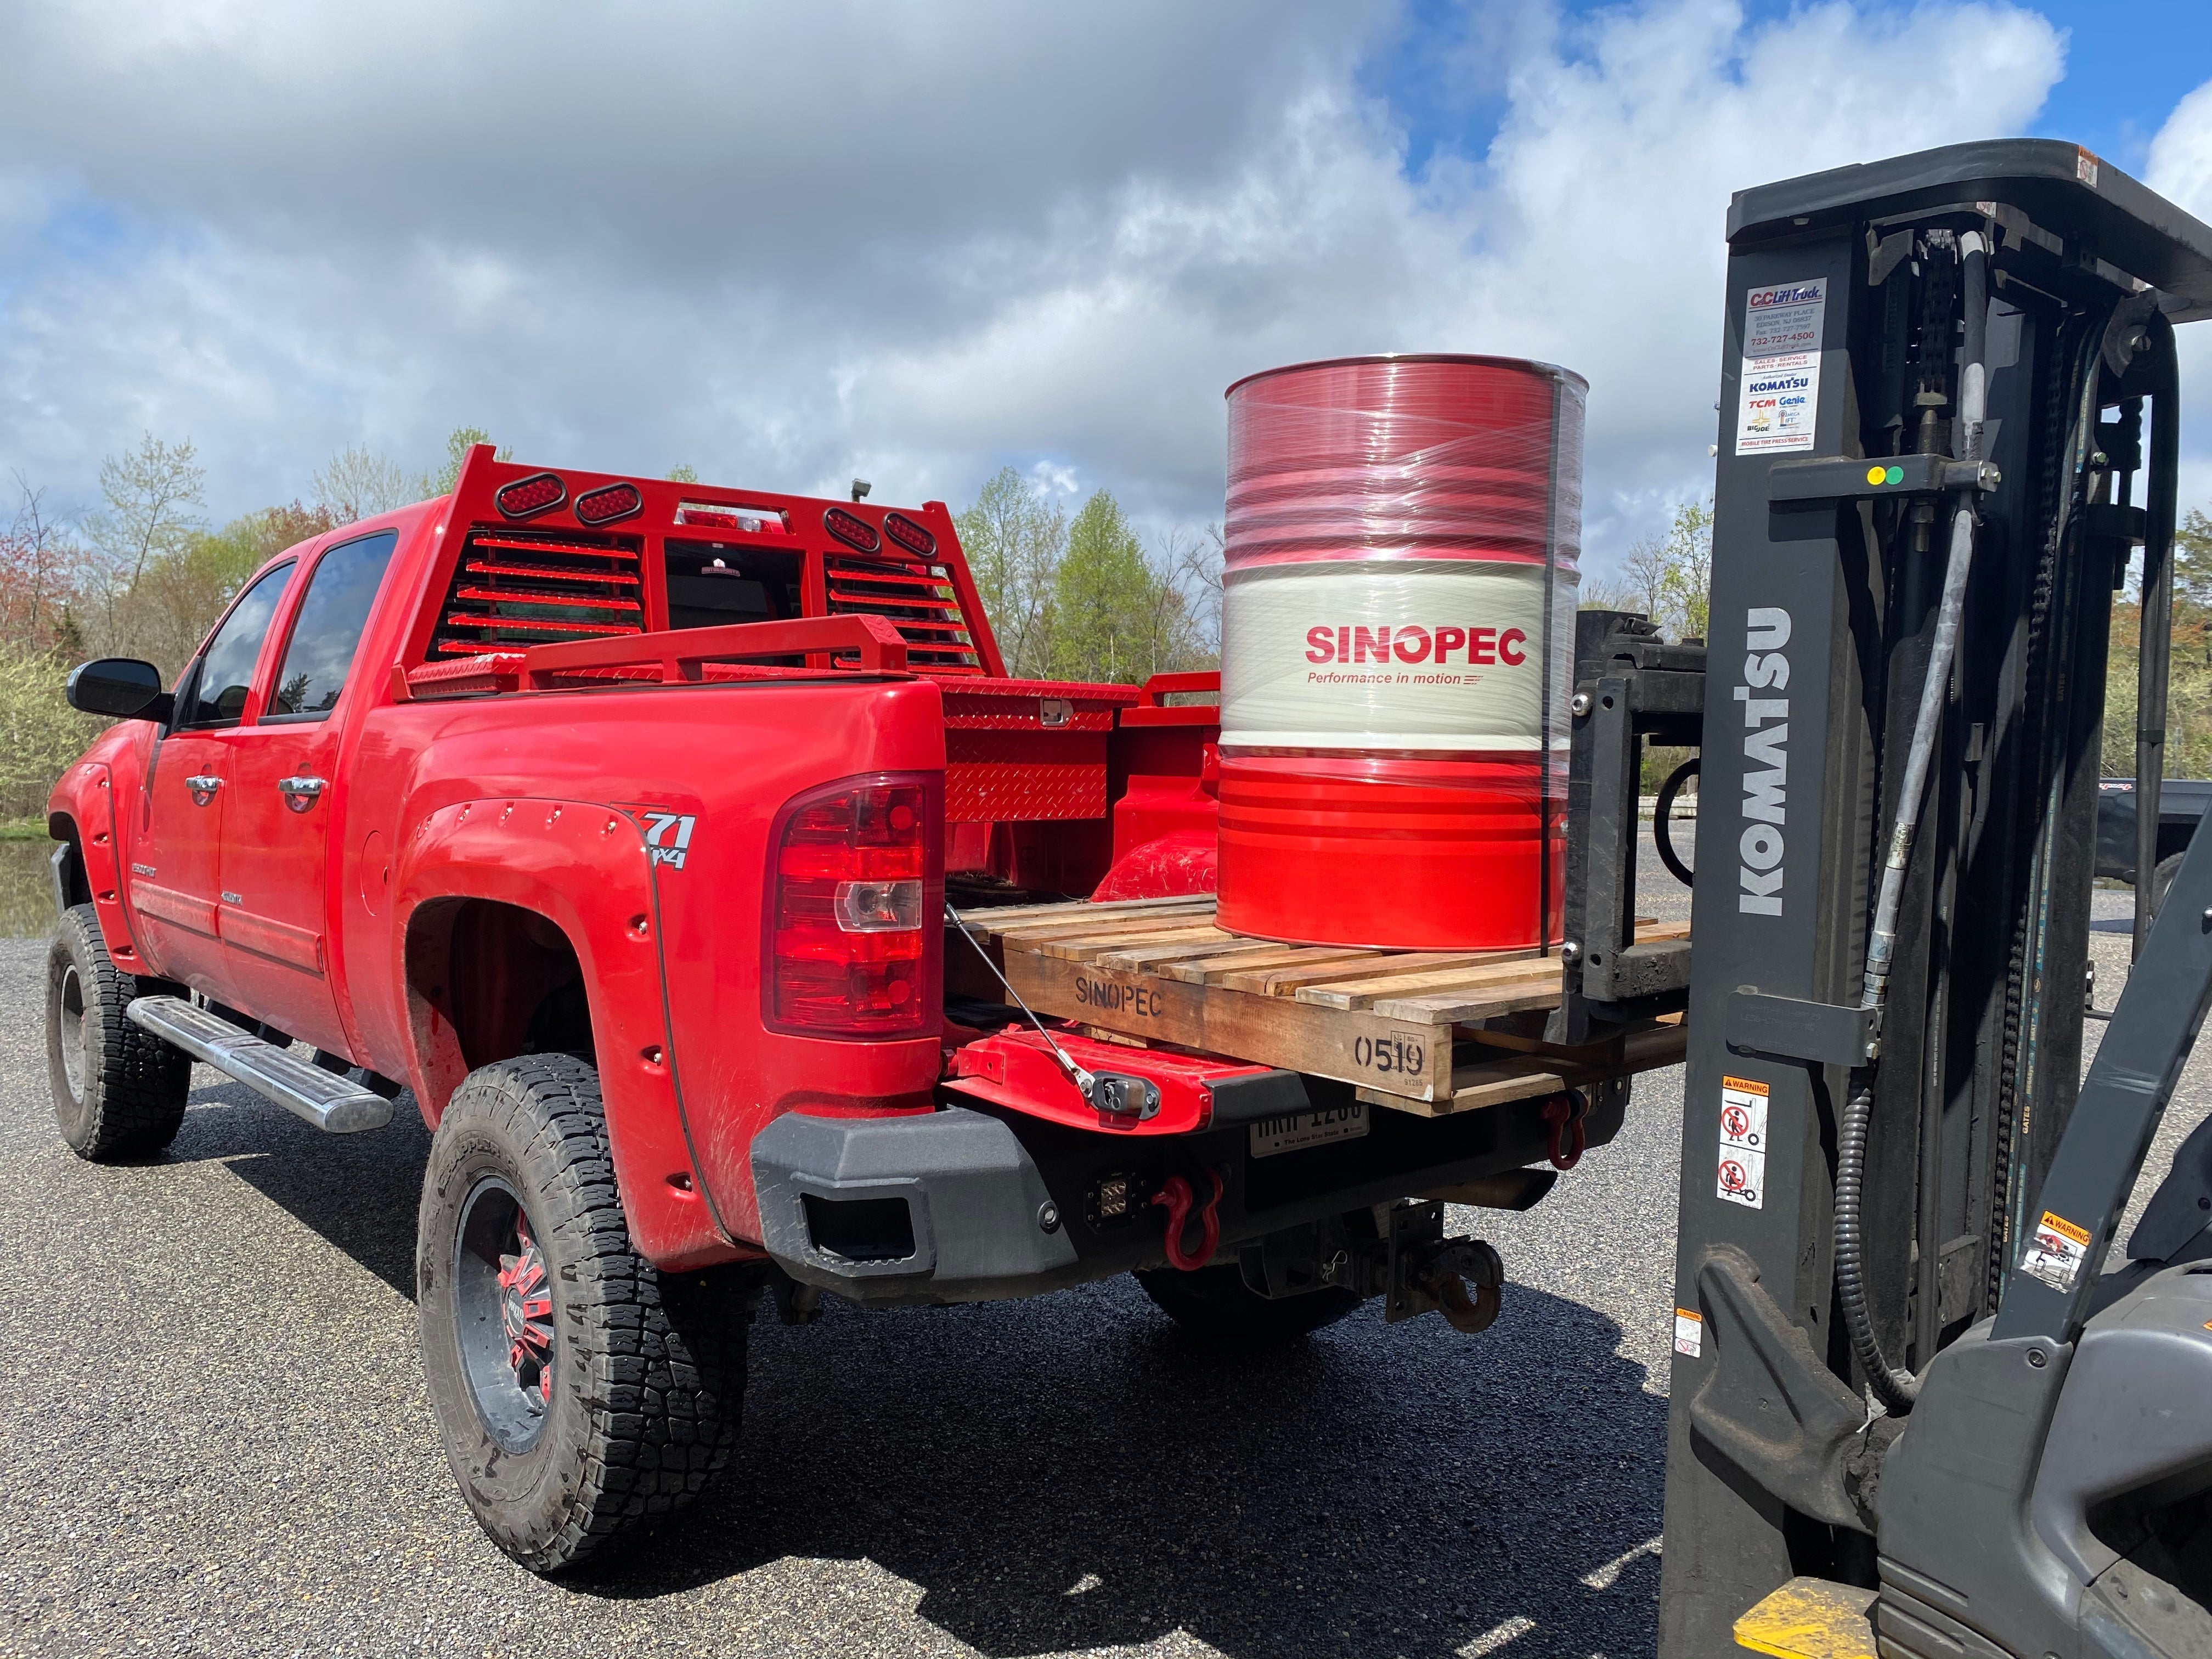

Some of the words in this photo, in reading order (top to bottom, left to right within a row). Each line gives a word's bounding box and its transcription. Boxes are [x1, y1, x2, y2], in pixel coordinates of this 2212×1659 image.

[1763, 312, 1793, 320] PARKWAY
[1794, 308, 1815, 317] PLACE
[1751, 331, 1814, 346] 732-727-4500
[1749, 377, 1809, 393] KOMATSU
[1749, 399, 1776, 409] TCM
[1779, 396, 1805, 406] Genie
[1305, 625, 1527, 666] SINOPEC
[1307, 672, 1392, 685] Performance
[1396, 672, 1409, 684] in
[1413, 673, 1460, 685] motion
[1734, 607, 1792, 917] KOMATSU
[1075, 977, 1162, 1018] SINOPEC
[1355, 1036, 1423, 1076] 0519
[1733, 1080, 1768, 1093] WARNING
[2022, 1106, 2030, 1134] GATES
[2055, 1221, 2089, 1243] WARNING
